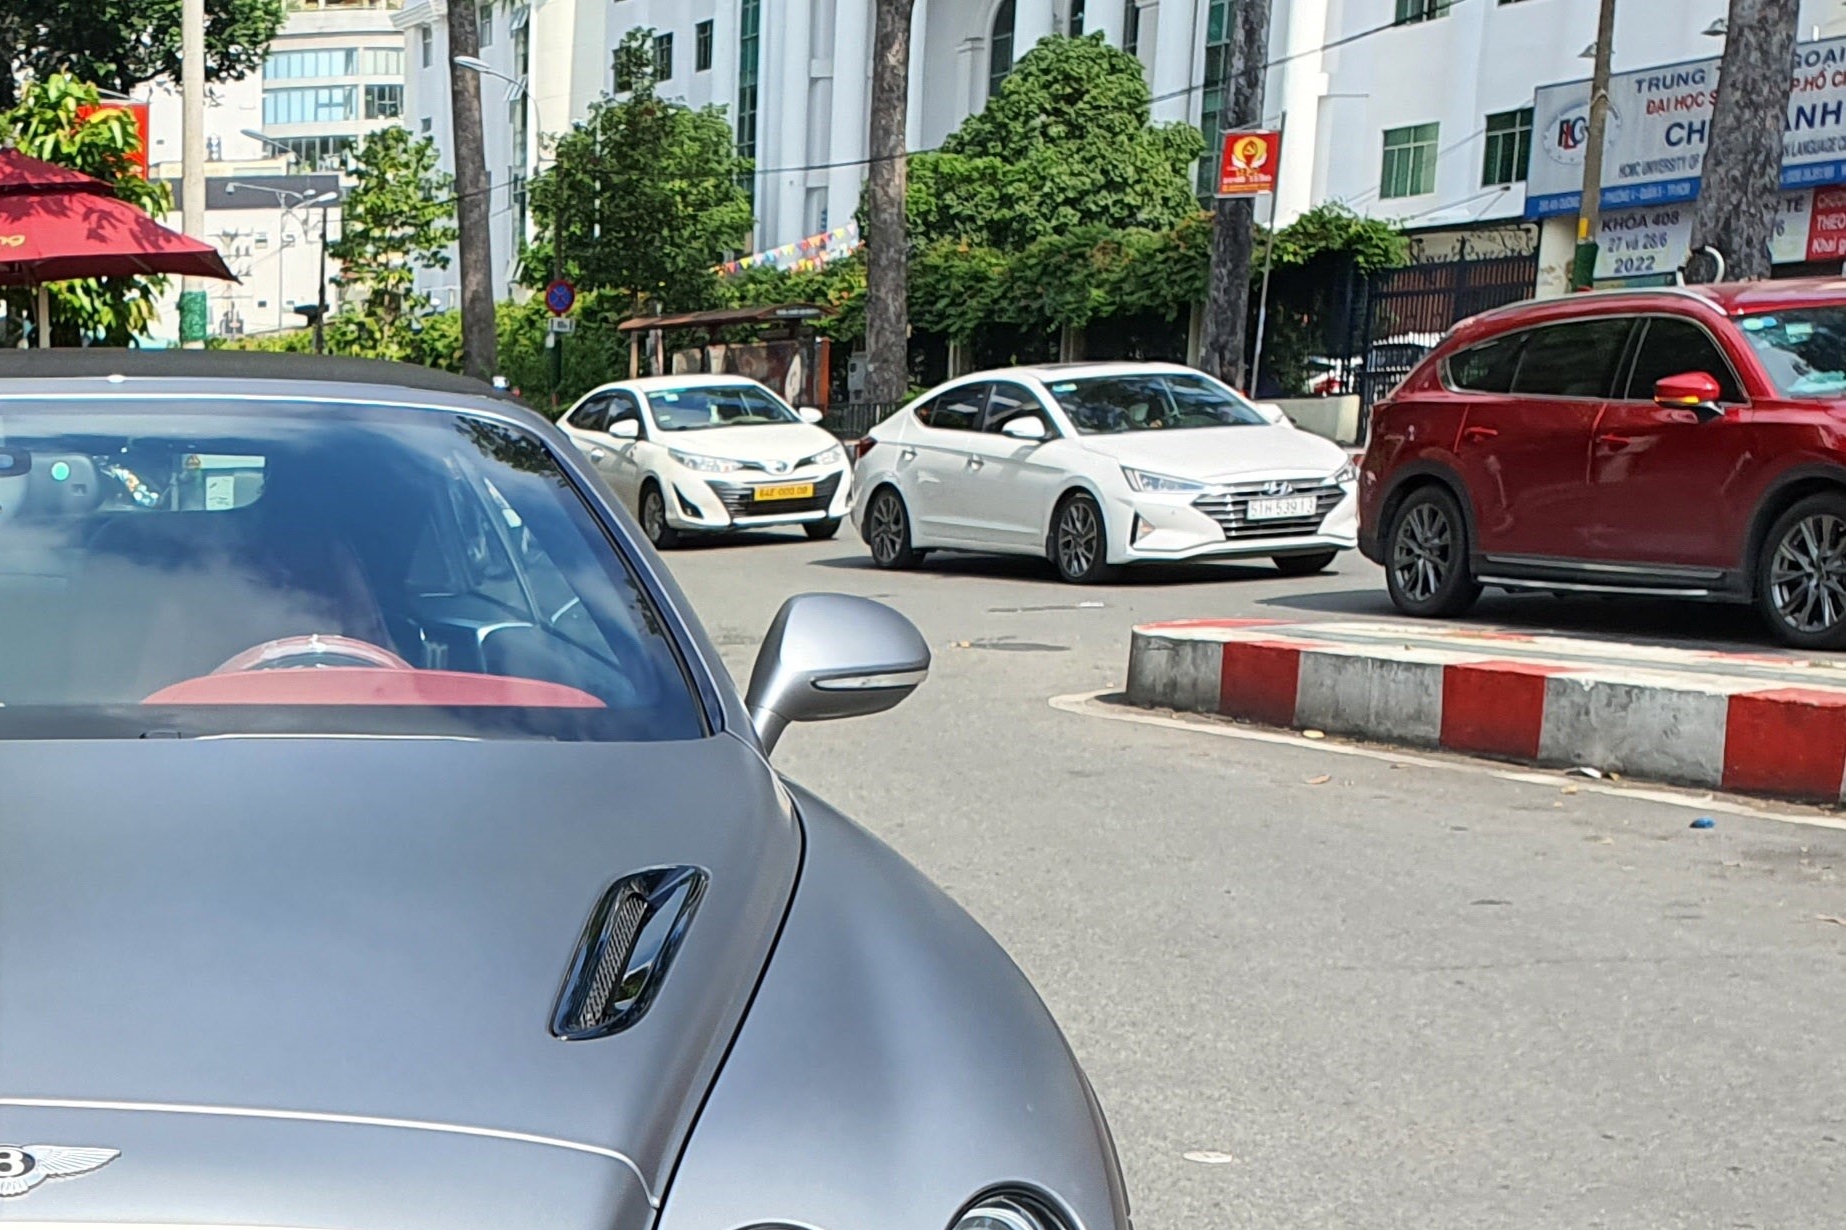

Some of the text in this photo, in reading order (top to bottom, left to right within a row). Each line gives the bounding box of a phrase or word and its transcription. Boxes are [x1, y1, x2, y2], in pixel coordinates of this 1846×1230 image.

[1635, 68, 1706, 94] TRUNG
[1646, 97, 1670, 117] ĐẠI
[1674, 91, 1705, 111] HỌC
[1665, 119, 1706, 147] CH
[1652, 210, 1680, 227] 408
[1608, 236, 1623, 253] 27
[1614, 255, 1656, 274] 2022
